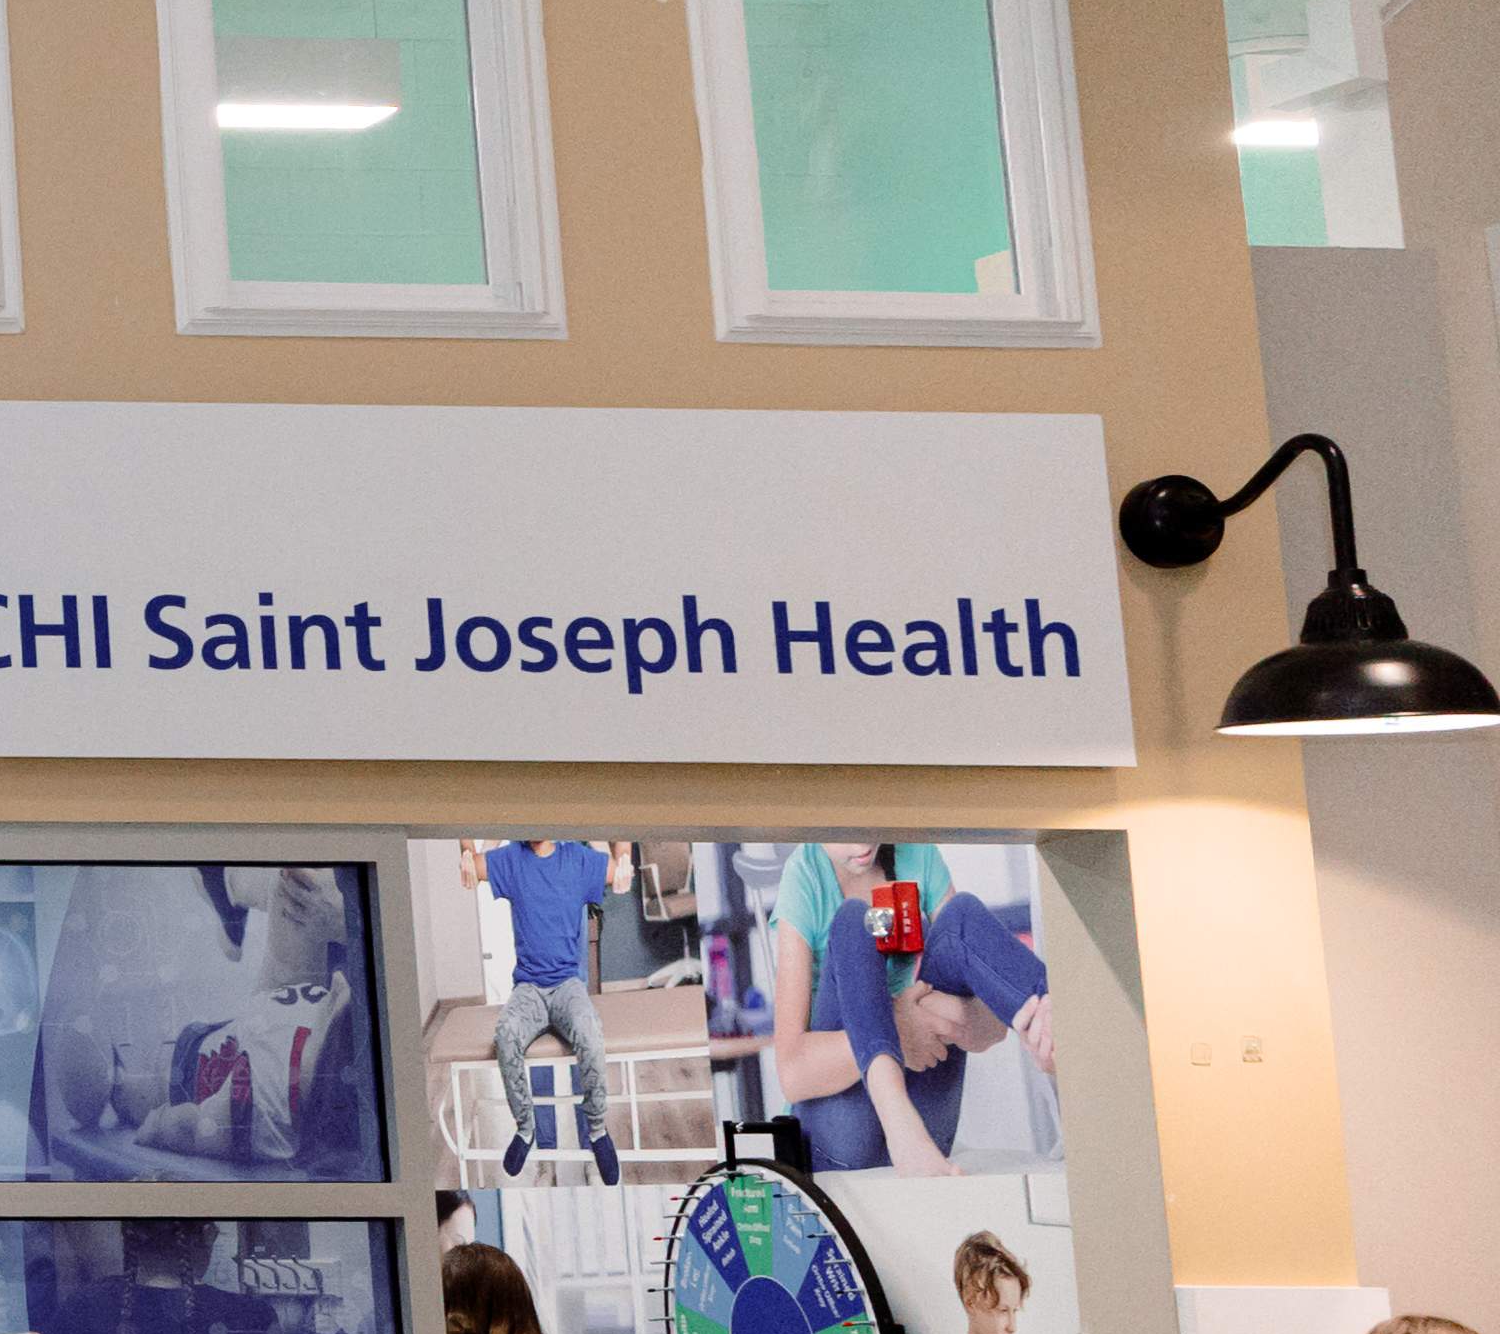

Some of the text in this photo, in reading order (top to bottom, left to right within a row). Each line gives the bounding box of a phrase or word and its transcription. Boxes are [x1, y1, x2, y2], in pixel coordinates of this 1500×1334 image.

[144, 591, 385, 673] Saint
[416, 595, 738, 695] Joseph
[772, 599, 1081, 678] Health
